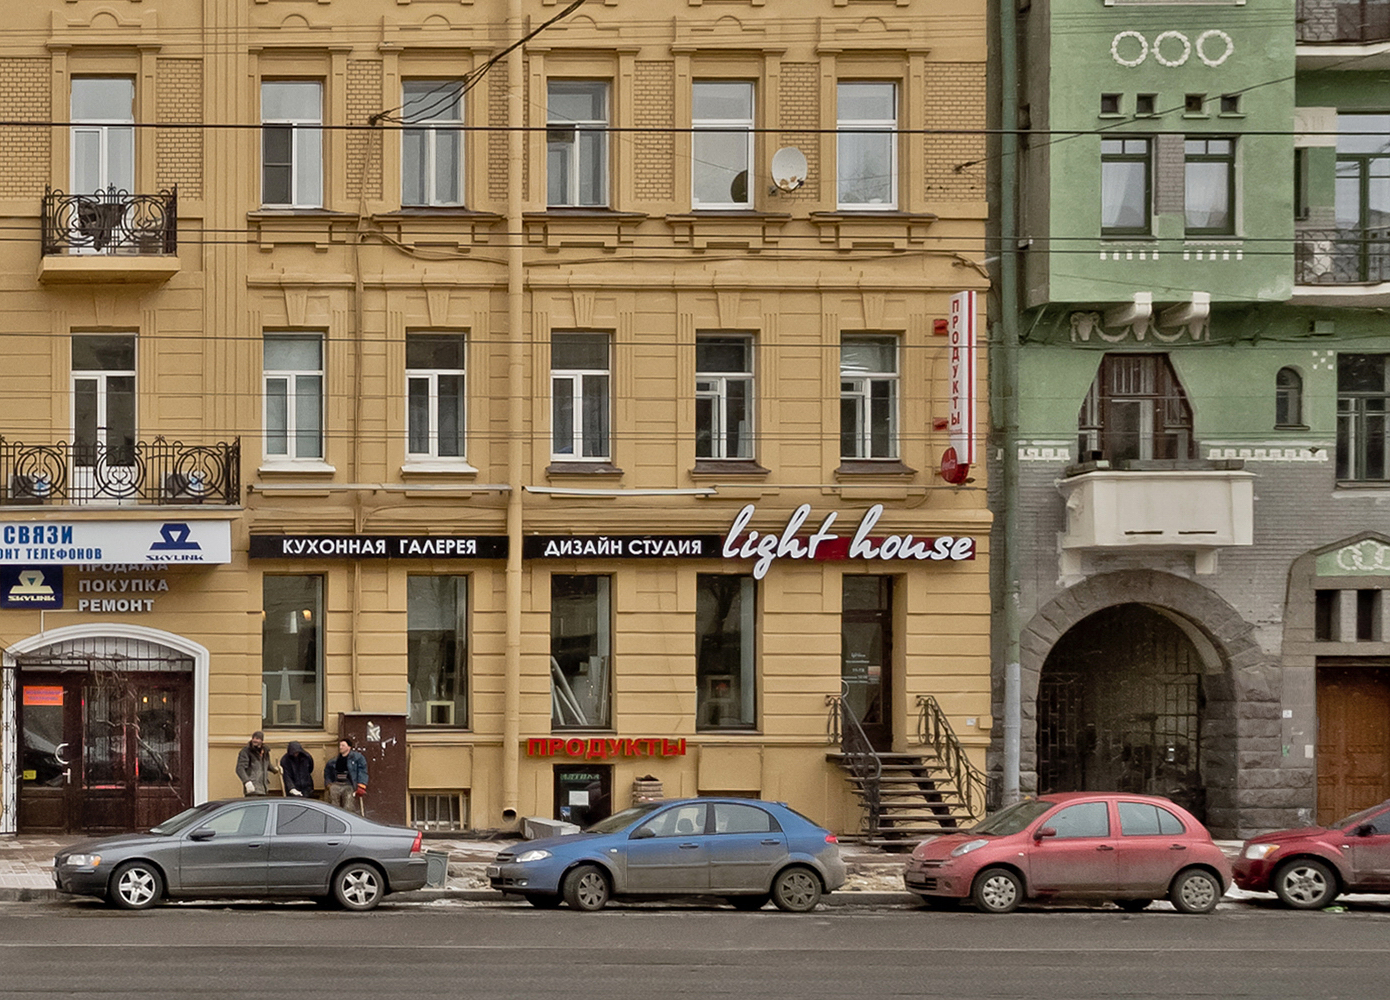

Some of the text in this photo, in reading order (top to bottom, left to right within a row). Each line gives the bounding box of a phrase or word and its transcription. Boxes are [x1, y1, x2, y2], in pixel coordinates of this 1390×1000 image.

[951, 300, 961, 426] ПРОДУКТЫ
[3, 525, 74, 545] СВЯЗИ
[722, 503, 974, 580] light house
[27, 547, 102, 560] ТЕЛЕФОНОВ
[282, 539, 477, 554] КУХОННАЯ ГАЛЕРЕЯ
[543, 536, 702, 557] ДИЗАЙН СТУДИЯ
[78, 579, 170, 592] ПОКУПКА
[7, 594, 56, 602] SKYLINK
[78, 599, 155, 612] РЕМОНТ
[527, 738, 686, 759] ПРОДУКТЫ
